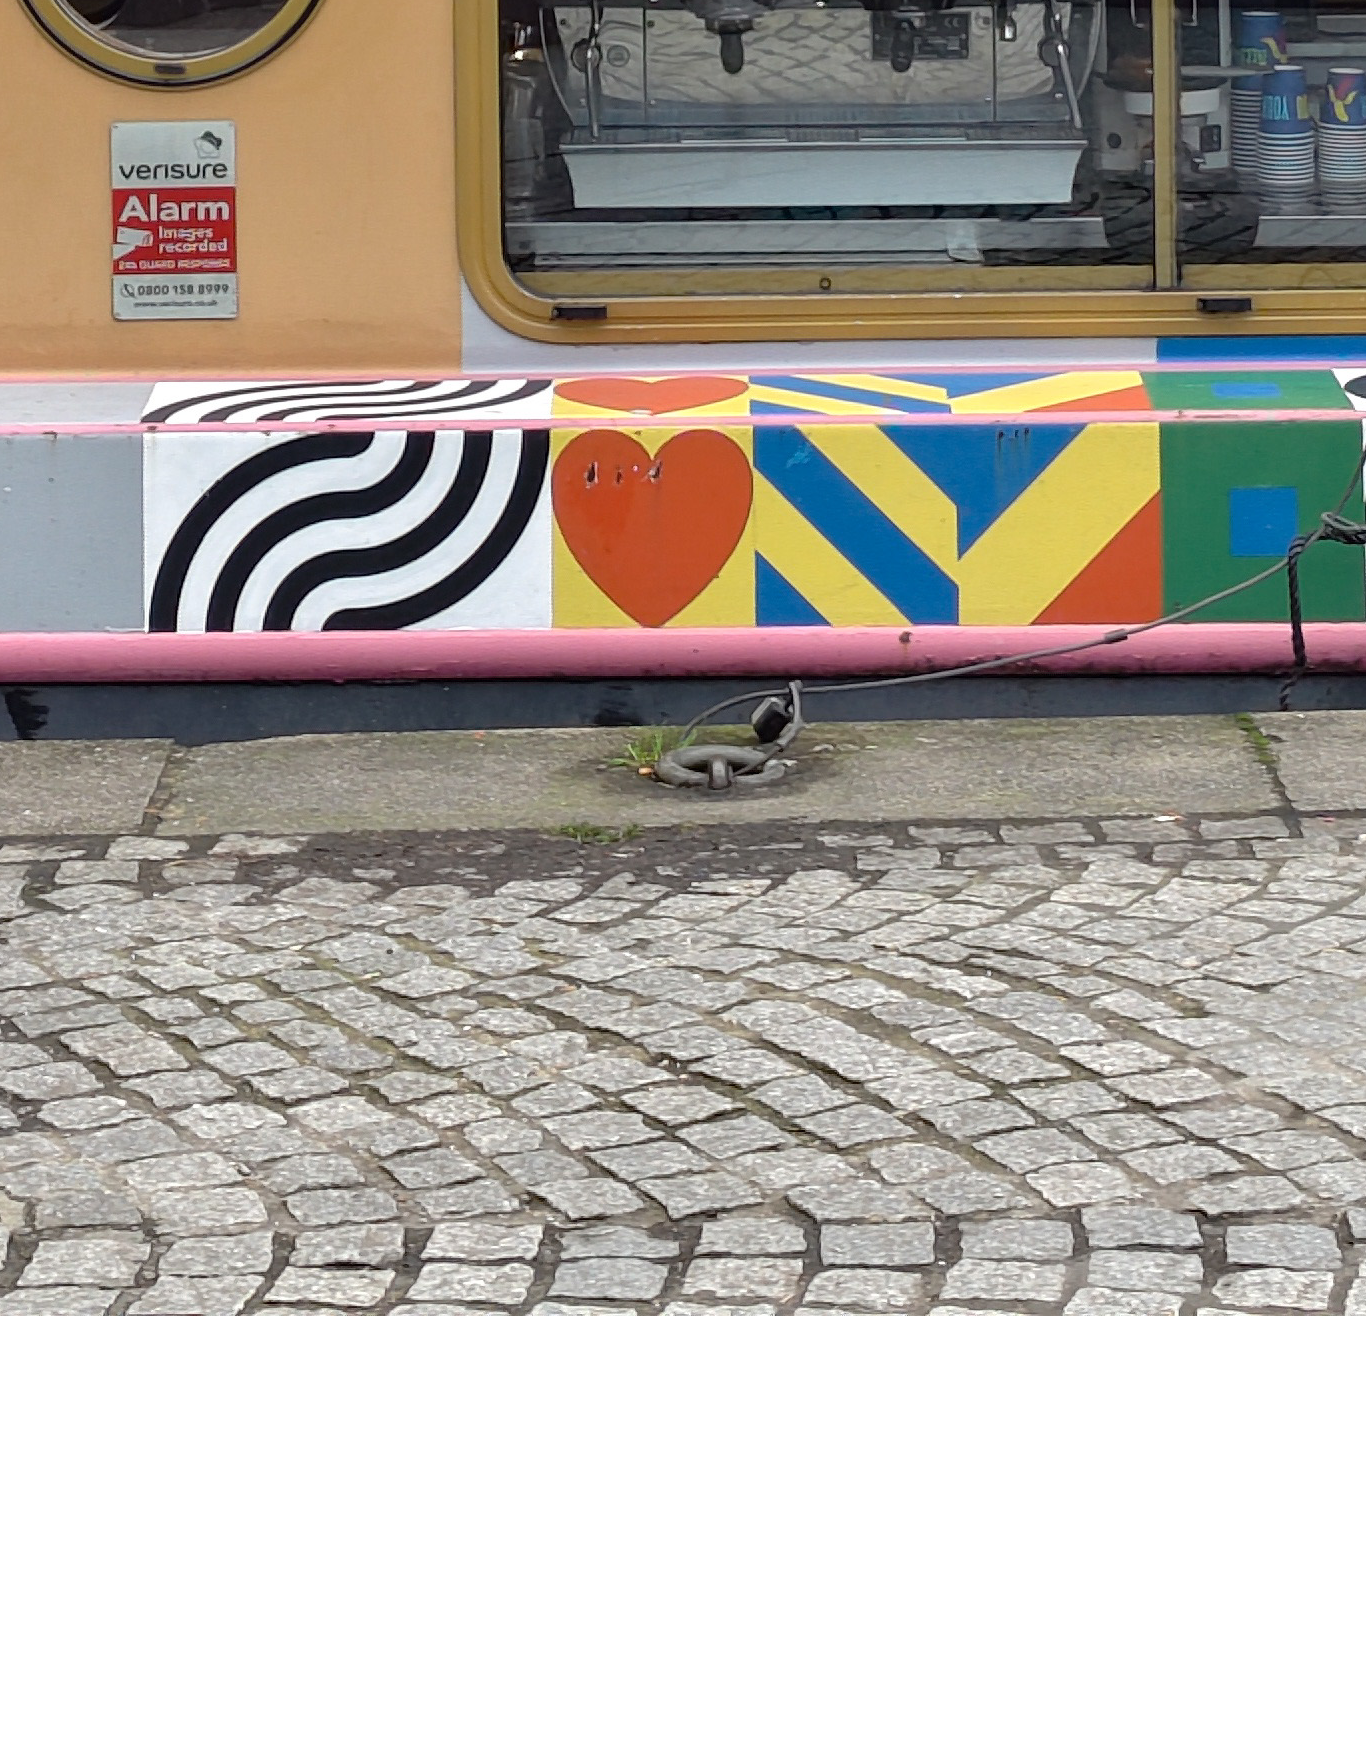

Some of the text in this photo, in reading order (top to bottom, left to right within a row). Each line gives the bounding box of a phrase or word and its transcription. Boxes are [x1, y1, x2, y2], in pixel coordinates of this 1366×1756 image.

[119, 162, 228, 180] verisure
[118, 193, 231, 223] Alarm
[158, 225, 214, 242] Images
[158, 237, 228, 254] recorded
[137, 285, 170, 296] 0800
